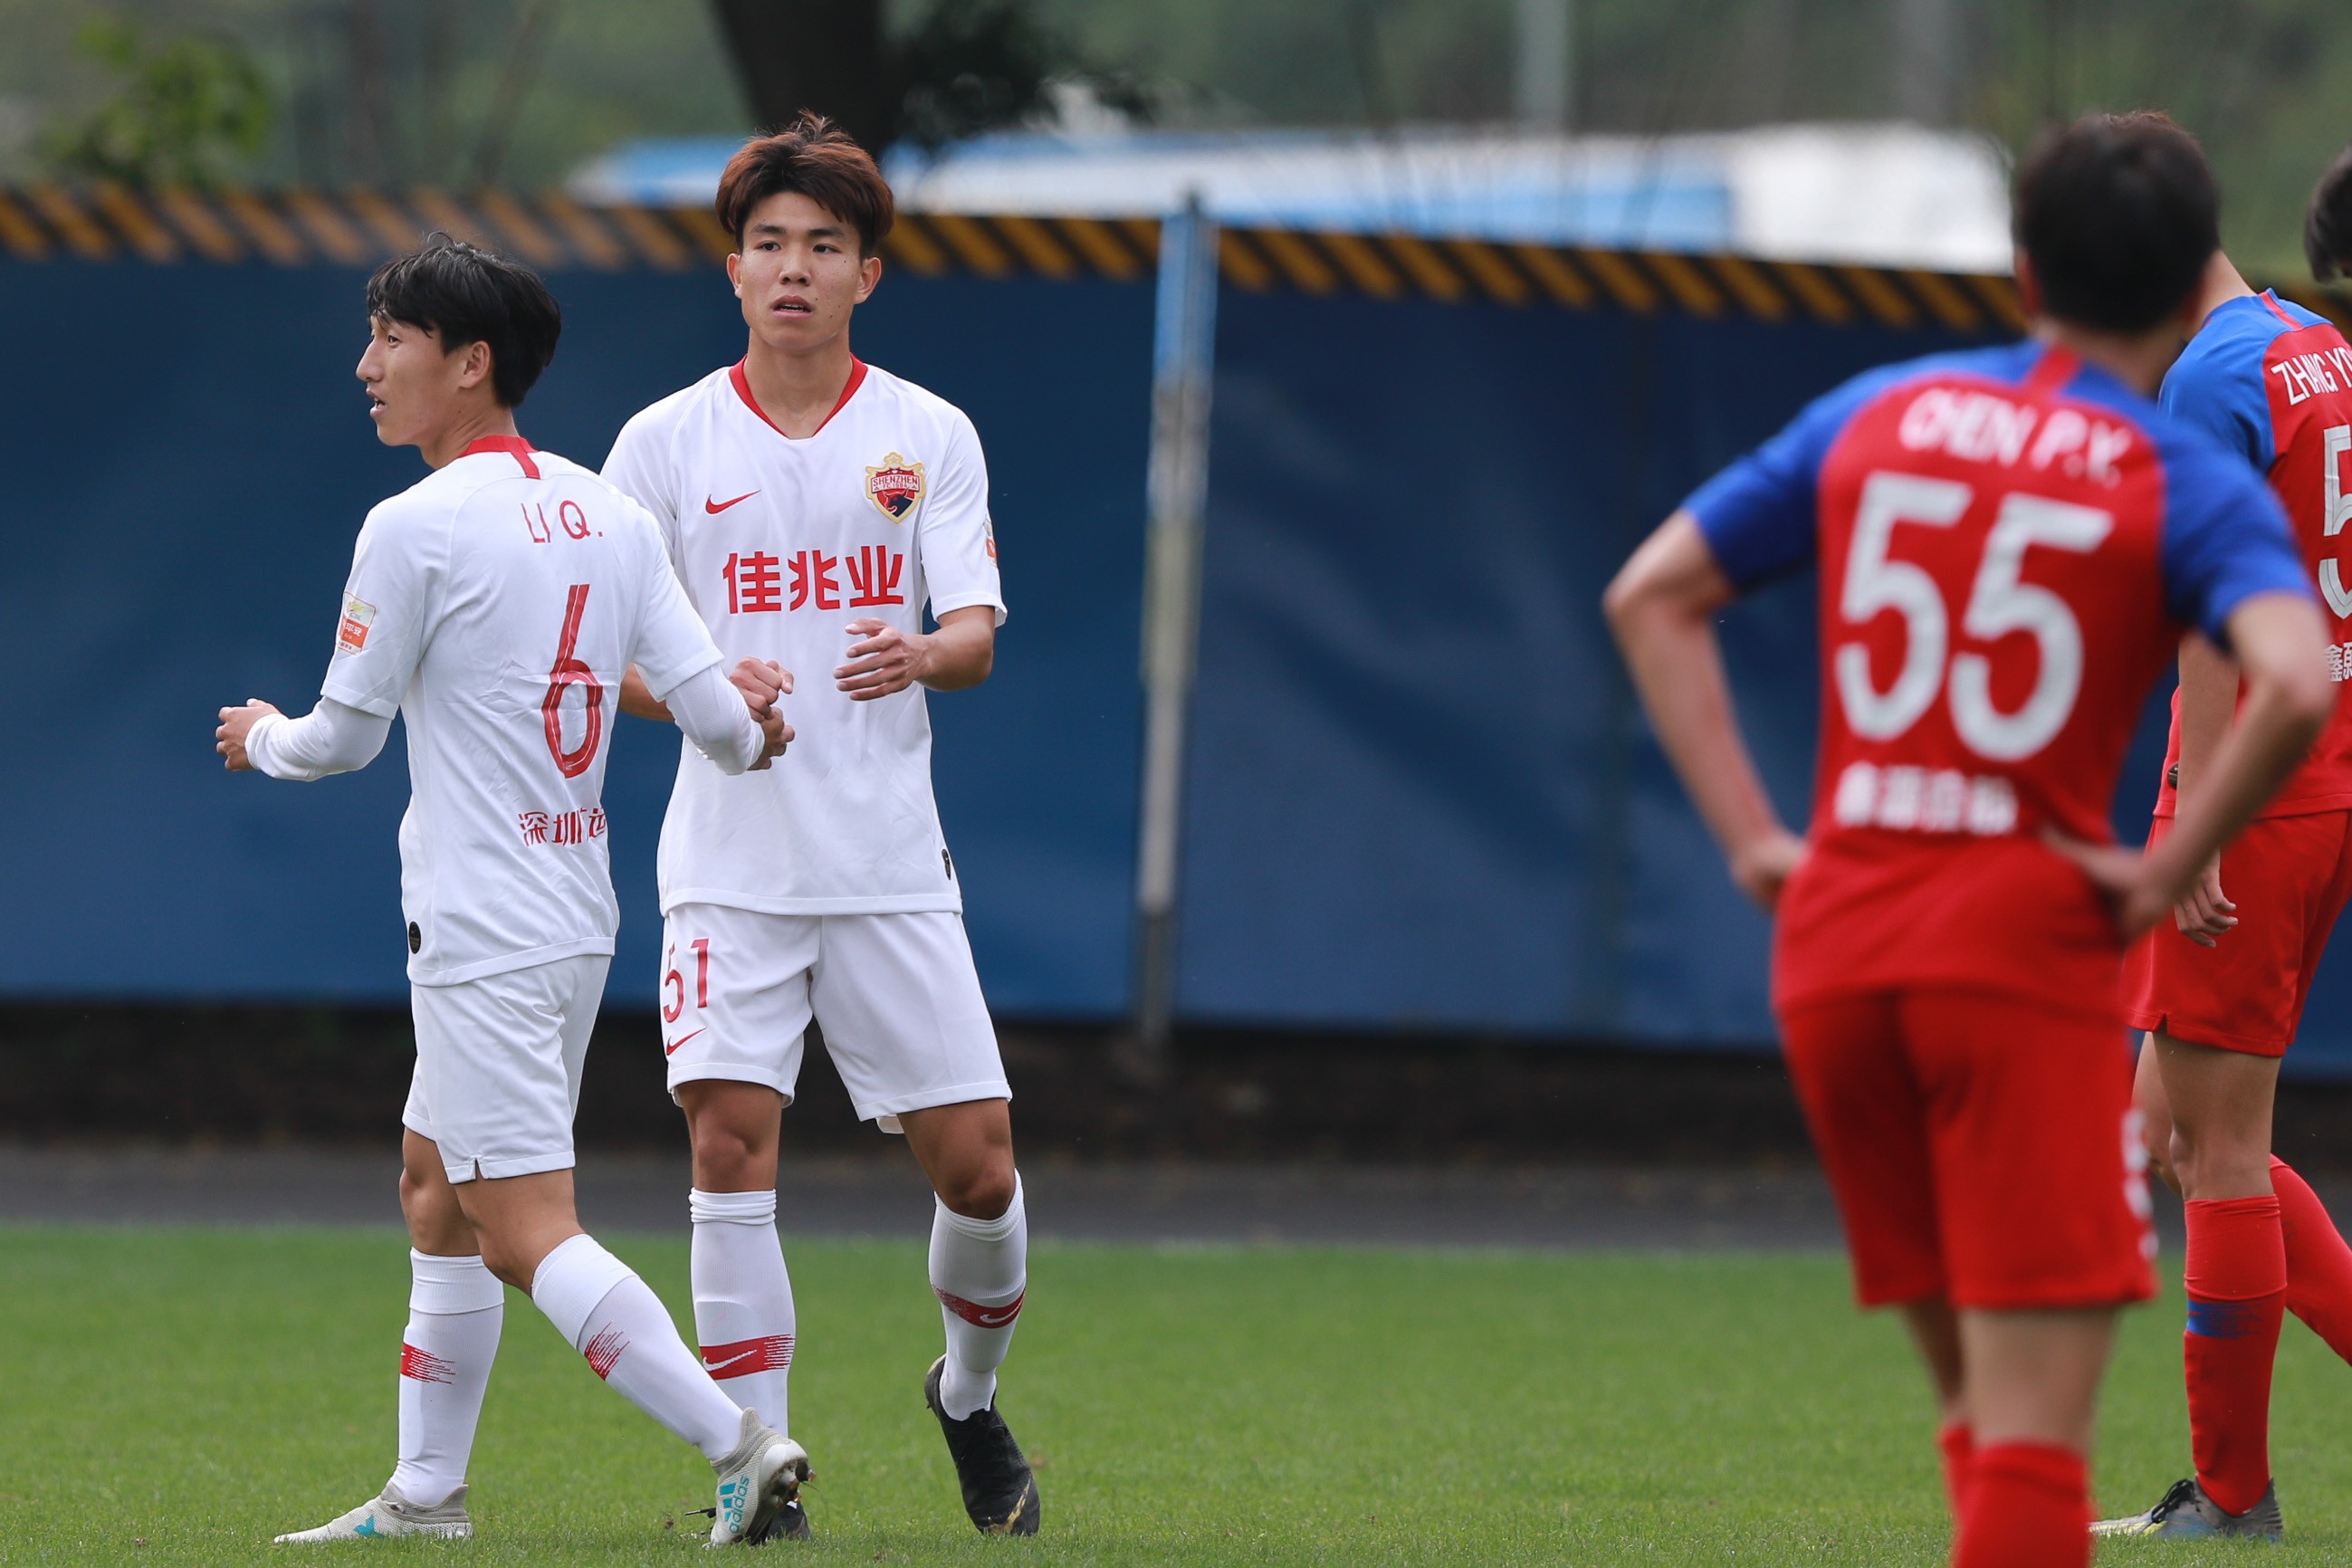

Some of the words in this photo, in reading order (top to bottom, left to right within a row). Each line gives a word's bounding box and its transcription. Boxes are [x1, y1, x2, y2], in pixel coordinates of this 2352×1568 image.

[873, 475, 918, 487] SHENZHEN
[521, 502, 551, 543] LI
[722, 545, 904, 614] 佳兆业
[1835, 469, 2114, 762] 55
[542, 583, 603, 779] 6
[663, 938, 710, 1024] 51
[729, 1476, 751, 1534] adidas
